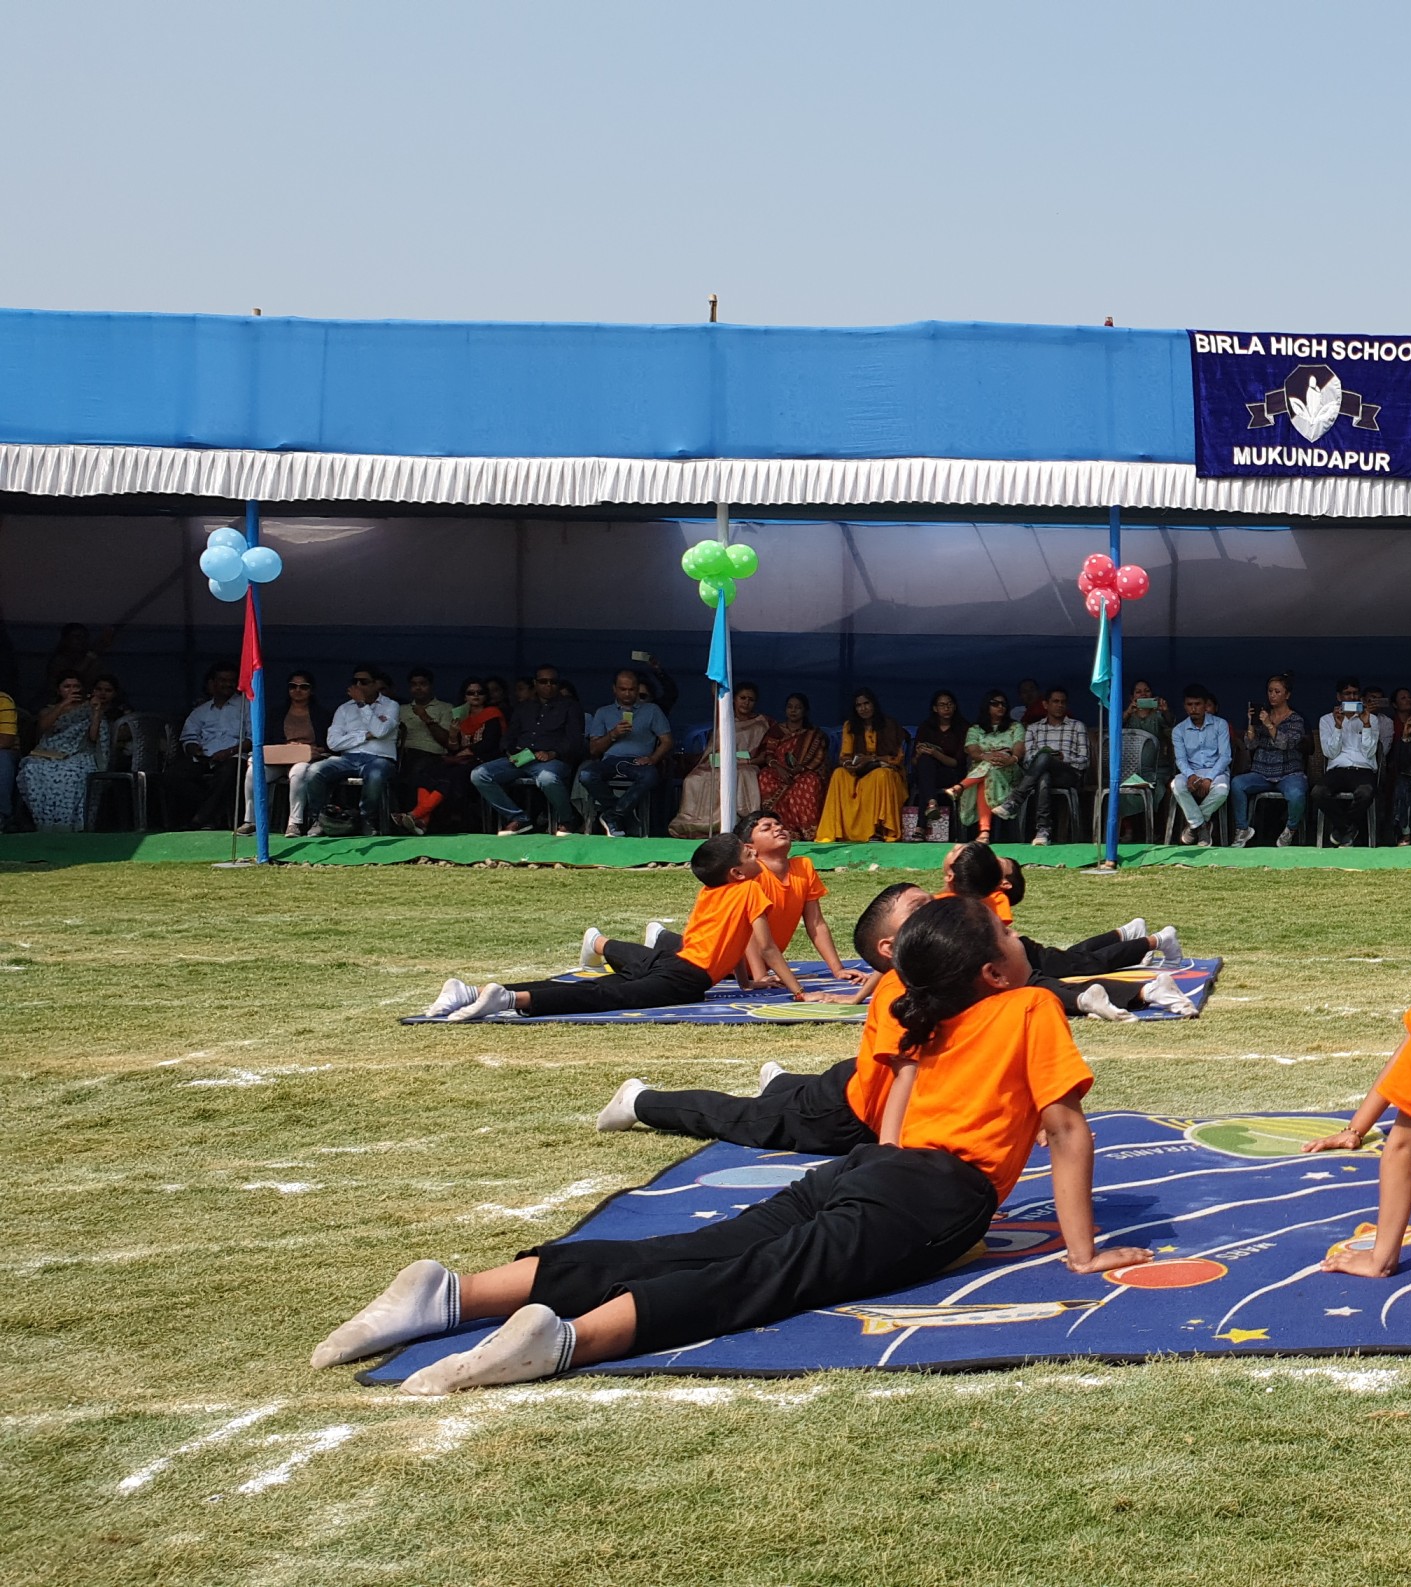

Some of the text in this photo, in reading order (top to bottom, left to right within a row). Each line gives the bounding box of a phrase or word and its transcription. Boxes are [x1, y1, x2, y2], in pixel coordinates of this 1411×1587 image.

[1195, 334, 1265, 355] BIRLA
[1271, 337, 1327, 359] HIGH
[1233, 446, 1390, 472] MUKUNDAPUR
[1103, 1145, 1198, 1160] URANUS
[1215, 1242, 1278, 1260] MARS
